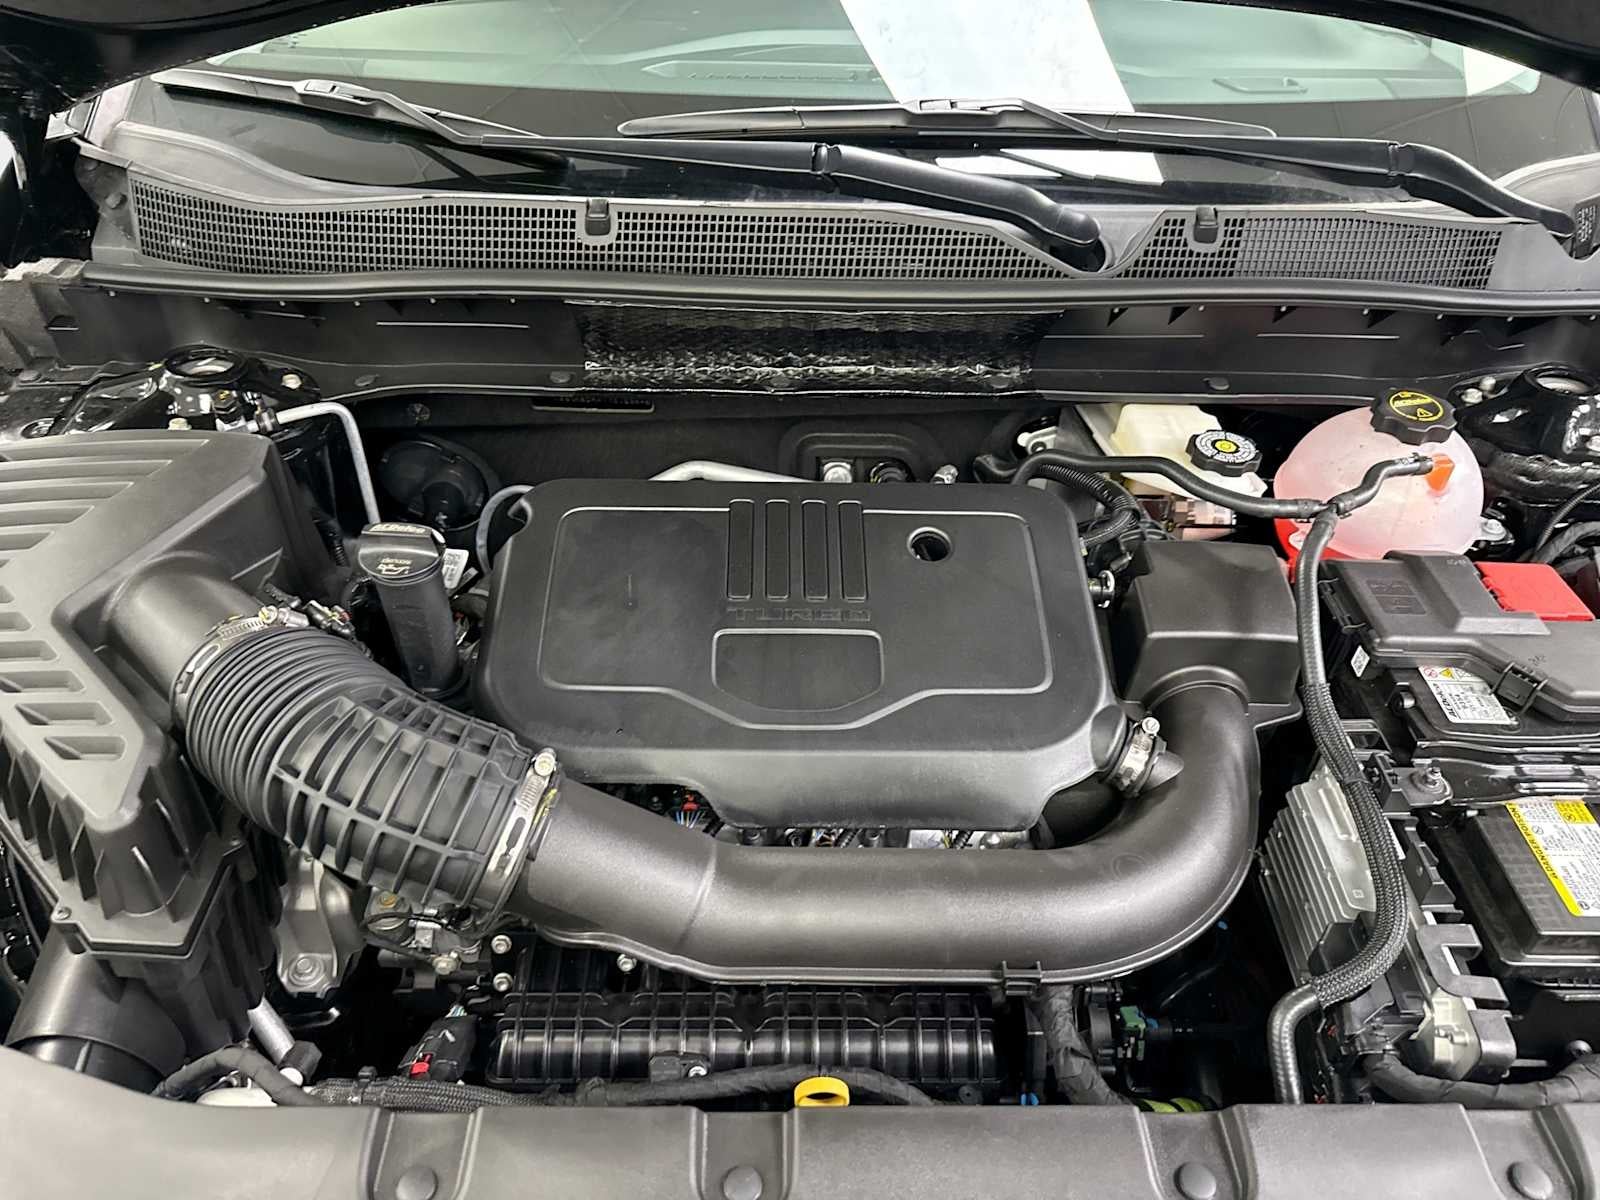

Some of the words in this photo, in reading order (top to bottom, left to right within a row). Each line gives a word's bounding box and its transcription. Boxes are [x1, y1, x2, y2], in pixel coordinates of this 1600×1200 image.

[727, 608, 871, 622] TURBO
[1509, 807, 1532, 838] POISON
[1529, 837, 1554, 874] DANGER
